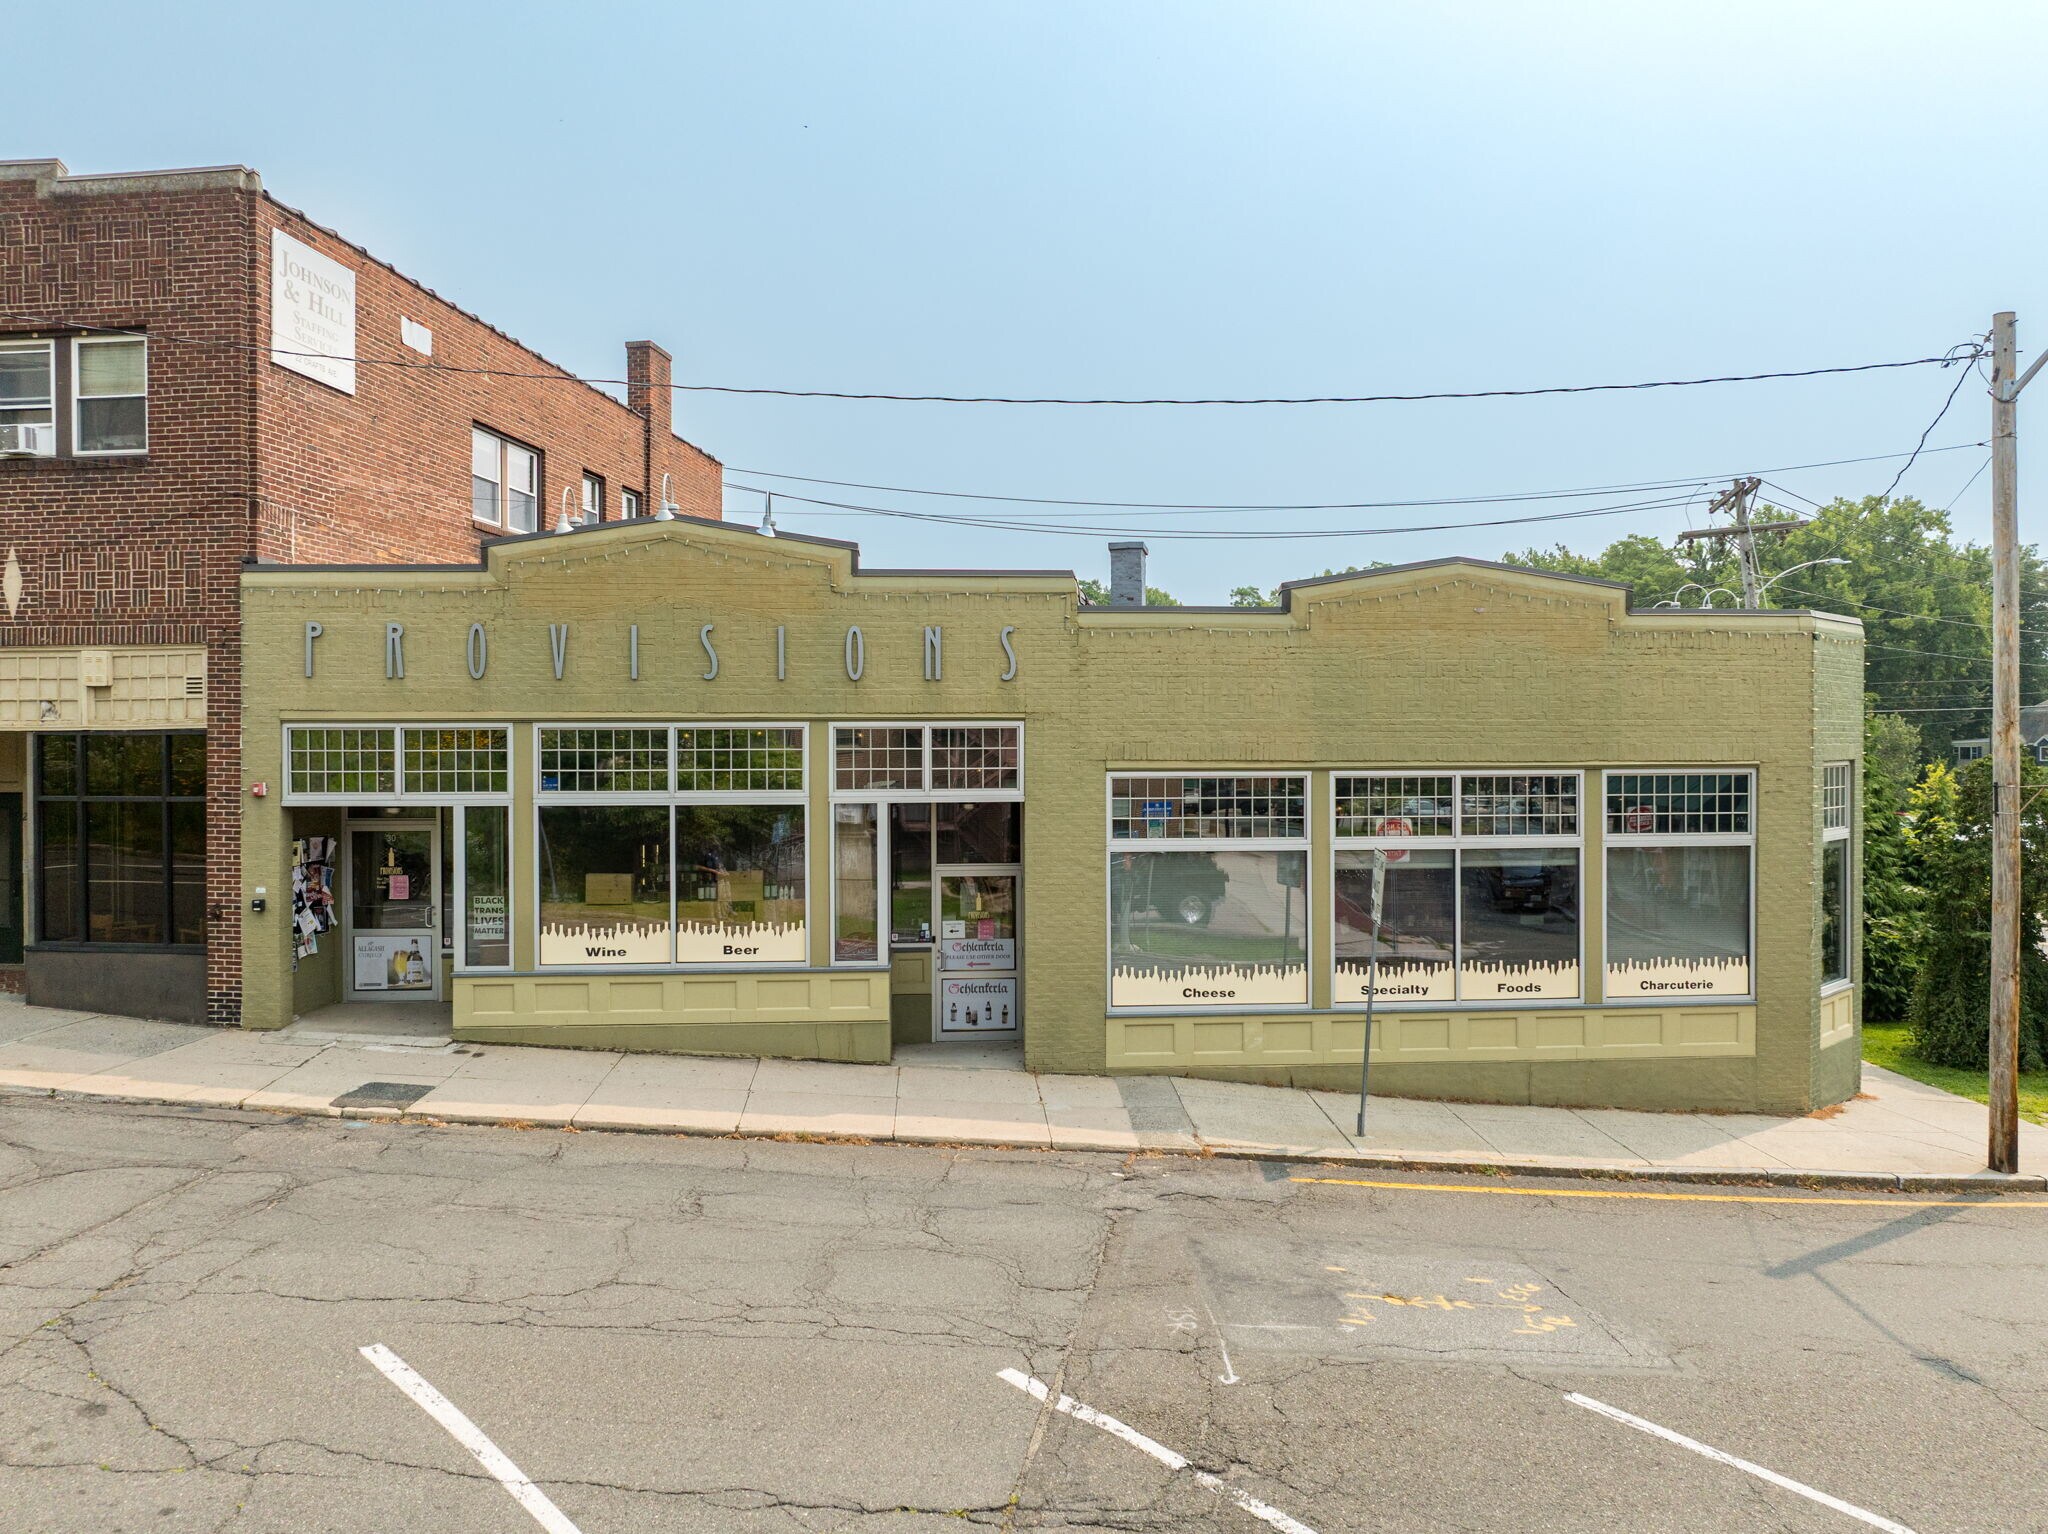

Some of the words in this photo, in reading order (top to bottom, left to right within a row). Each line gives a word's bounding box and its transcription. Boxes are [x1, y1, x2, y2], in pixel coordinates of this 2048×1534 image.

[284, 279, 299, 303] &
[305, 621, 1017, 681] PROVISIONS
[386, 834, 396, 842] 30
[475, 917, 503, 925] LIVES
[585, 946, 627, 957] Wine
[722, 945, 759, 956] Beer
[1497, 982, 1542, 993] Foods
[1639, 979, 1714, 990] Charcuterie
[1182, 987, 1236, 998] Cheese
